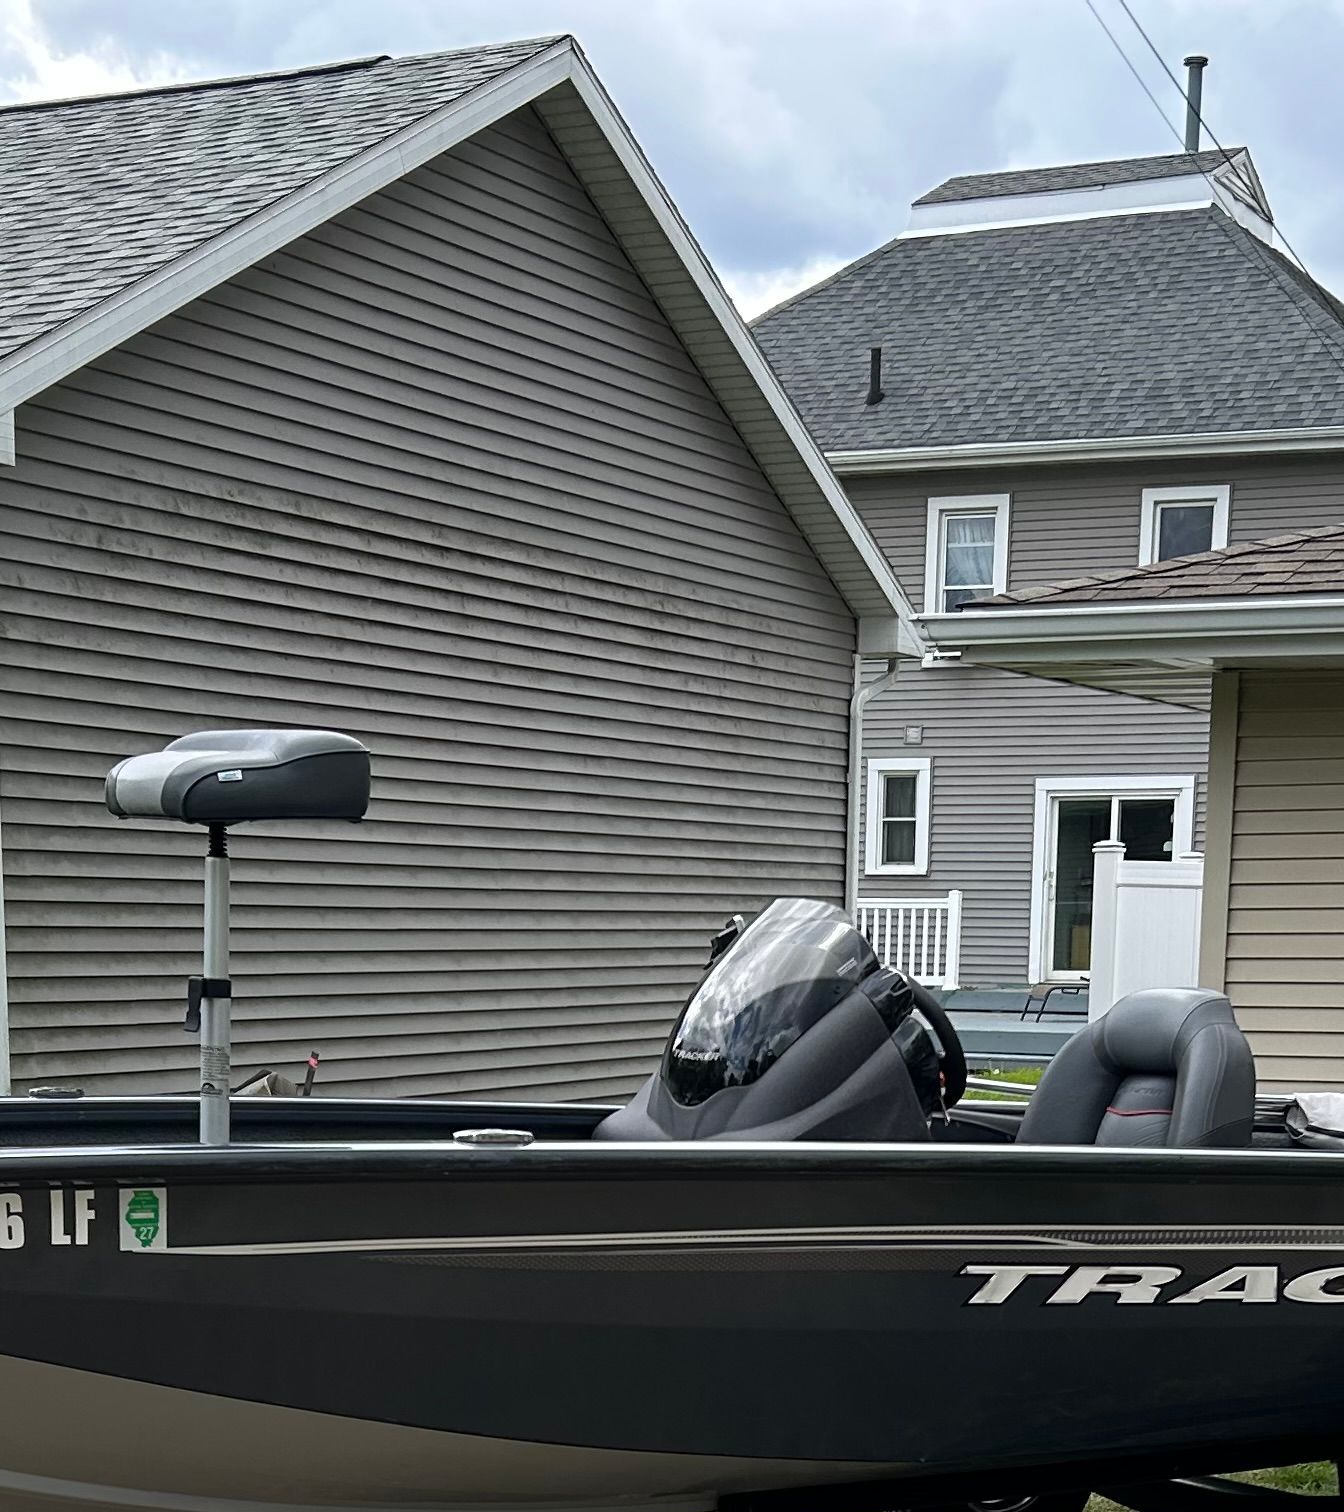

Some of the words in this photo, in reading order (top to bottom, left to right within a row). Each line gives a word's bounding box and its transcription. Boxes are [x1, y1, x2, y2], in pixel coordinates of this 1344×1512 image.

[673, 1049, 722, 1061] TRACKER
[50, 1189, 96, 1246] LF
[139, 1226, 155, 1240] 27
